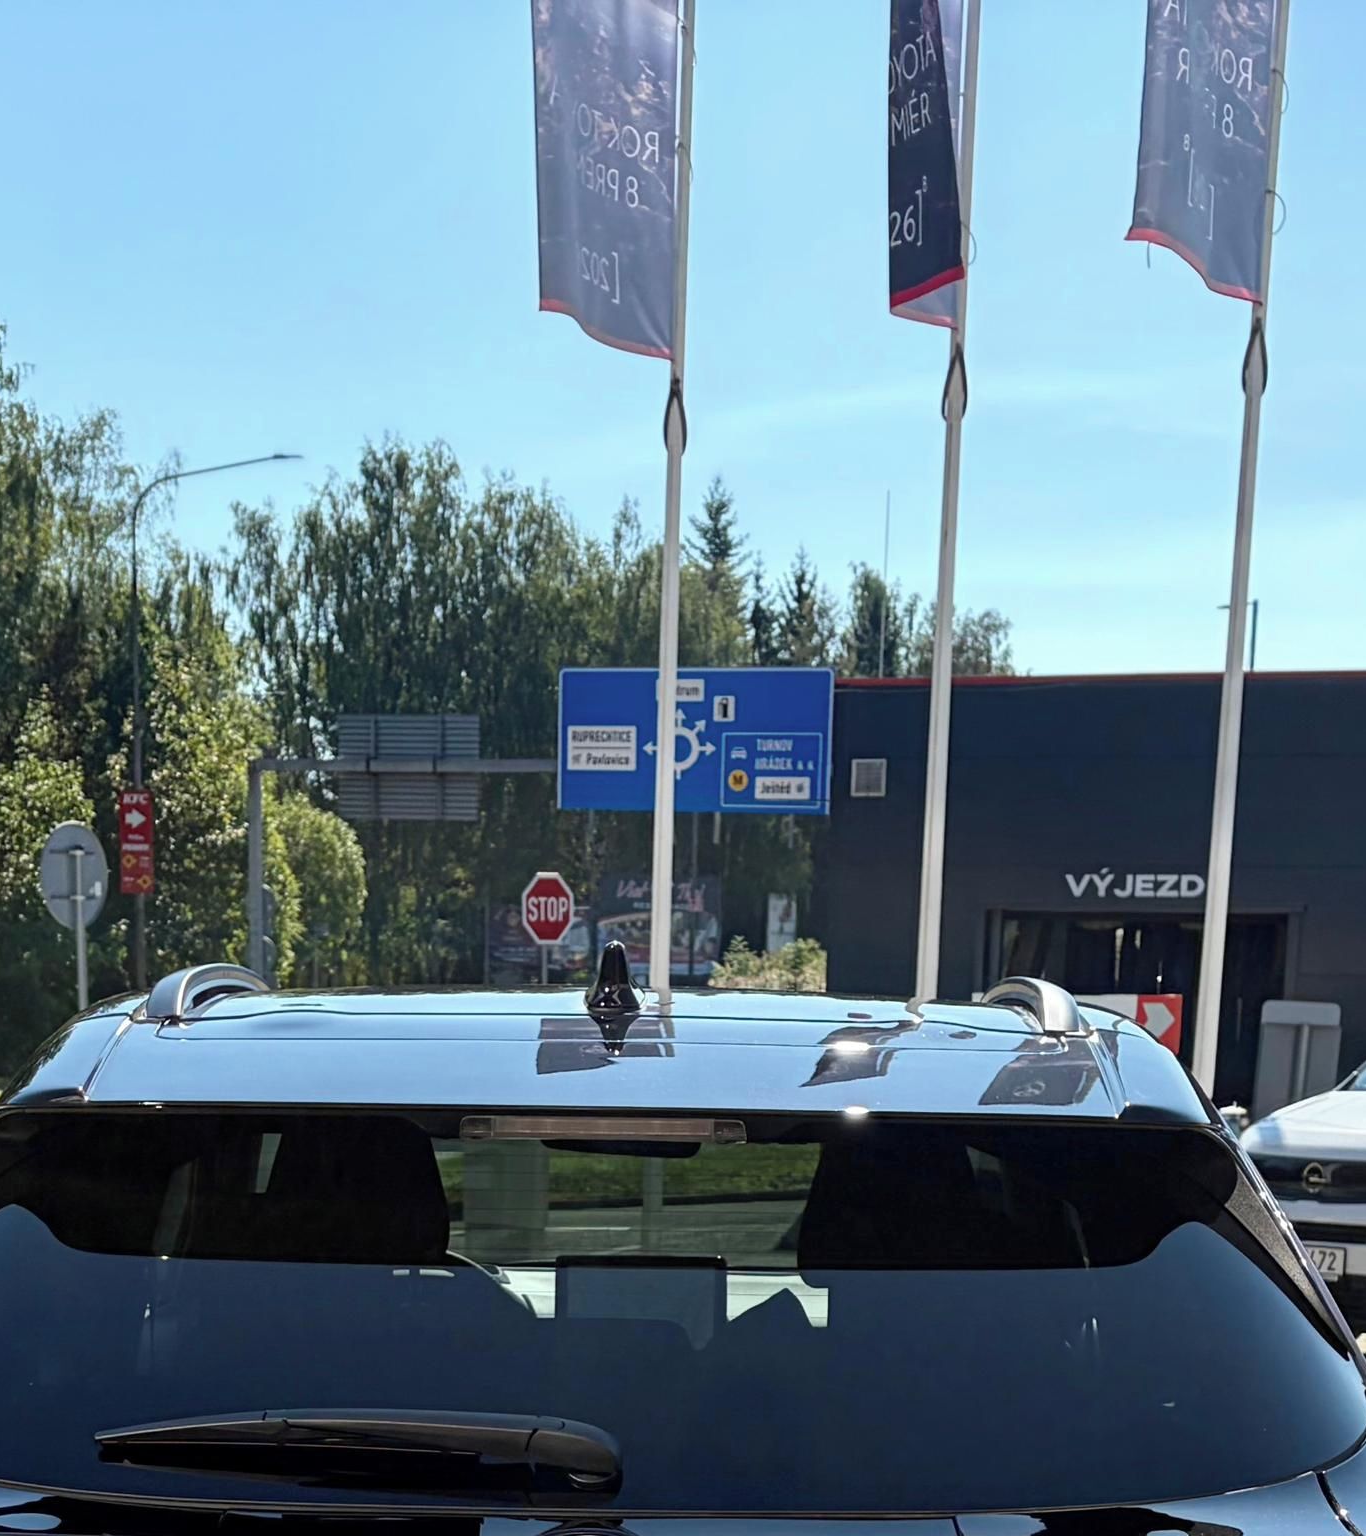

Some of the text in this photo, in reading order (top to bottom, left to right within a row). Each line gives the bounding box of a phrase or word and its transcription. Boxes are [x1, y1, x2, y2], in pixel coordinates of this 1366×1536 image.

[888, 31, 937, 94] OYOTA
[890, 89, 932, 147] MIÉR
[1064, 867, 1206, 898] VÝJEZD
[527, 896, 569, 922] STOP
